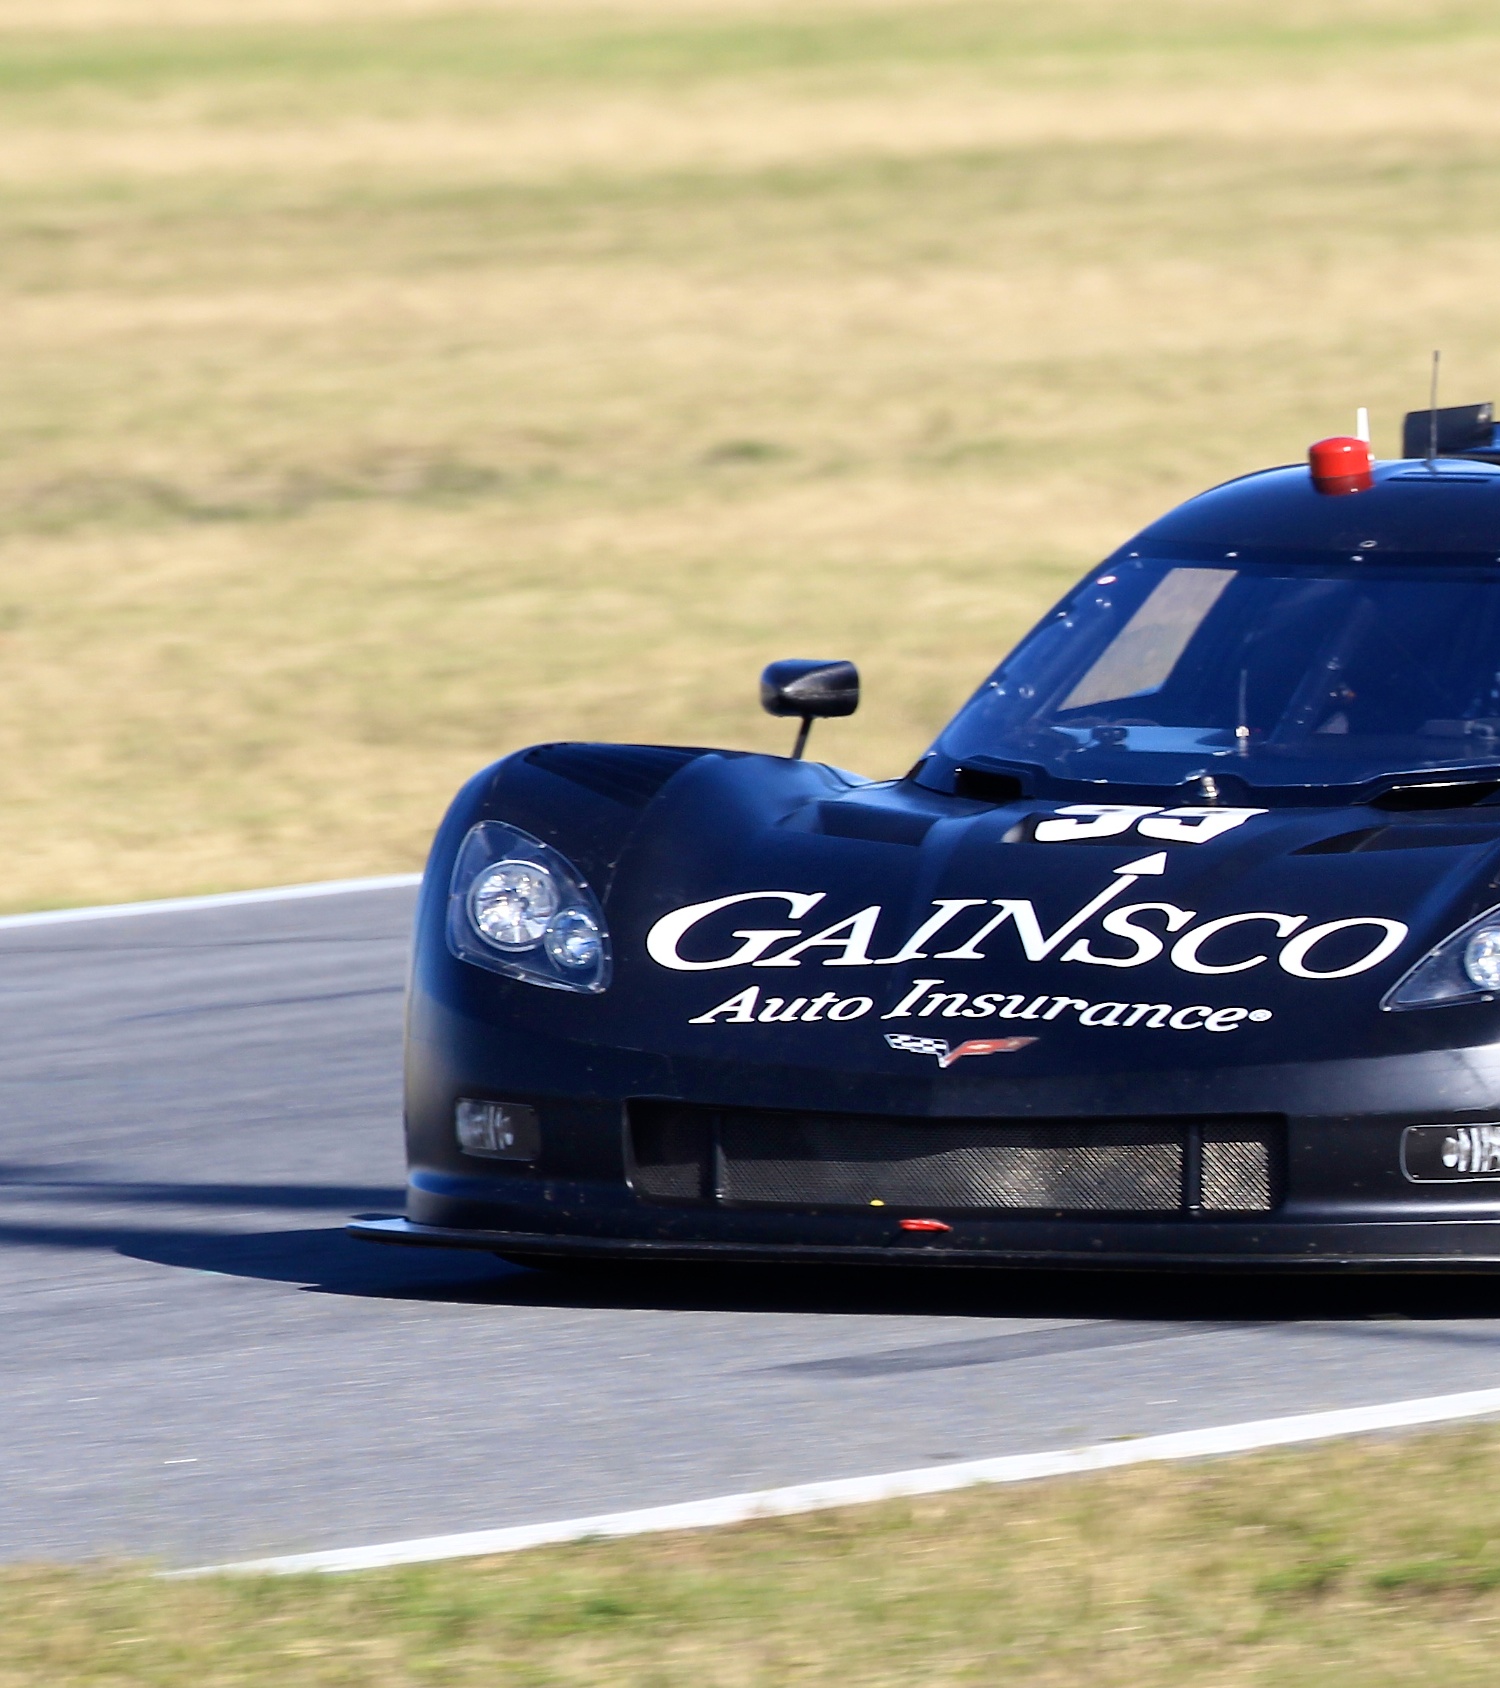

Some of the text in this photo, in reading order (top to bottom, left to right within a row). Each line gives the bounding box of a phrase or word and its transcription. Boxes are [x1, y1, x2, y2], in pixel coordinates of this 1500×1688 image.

[1034, 804, 1269, 843] 99
[646, 872, 1408, 979] GAINSCO
[689, 985, 872, 1024] Auto
